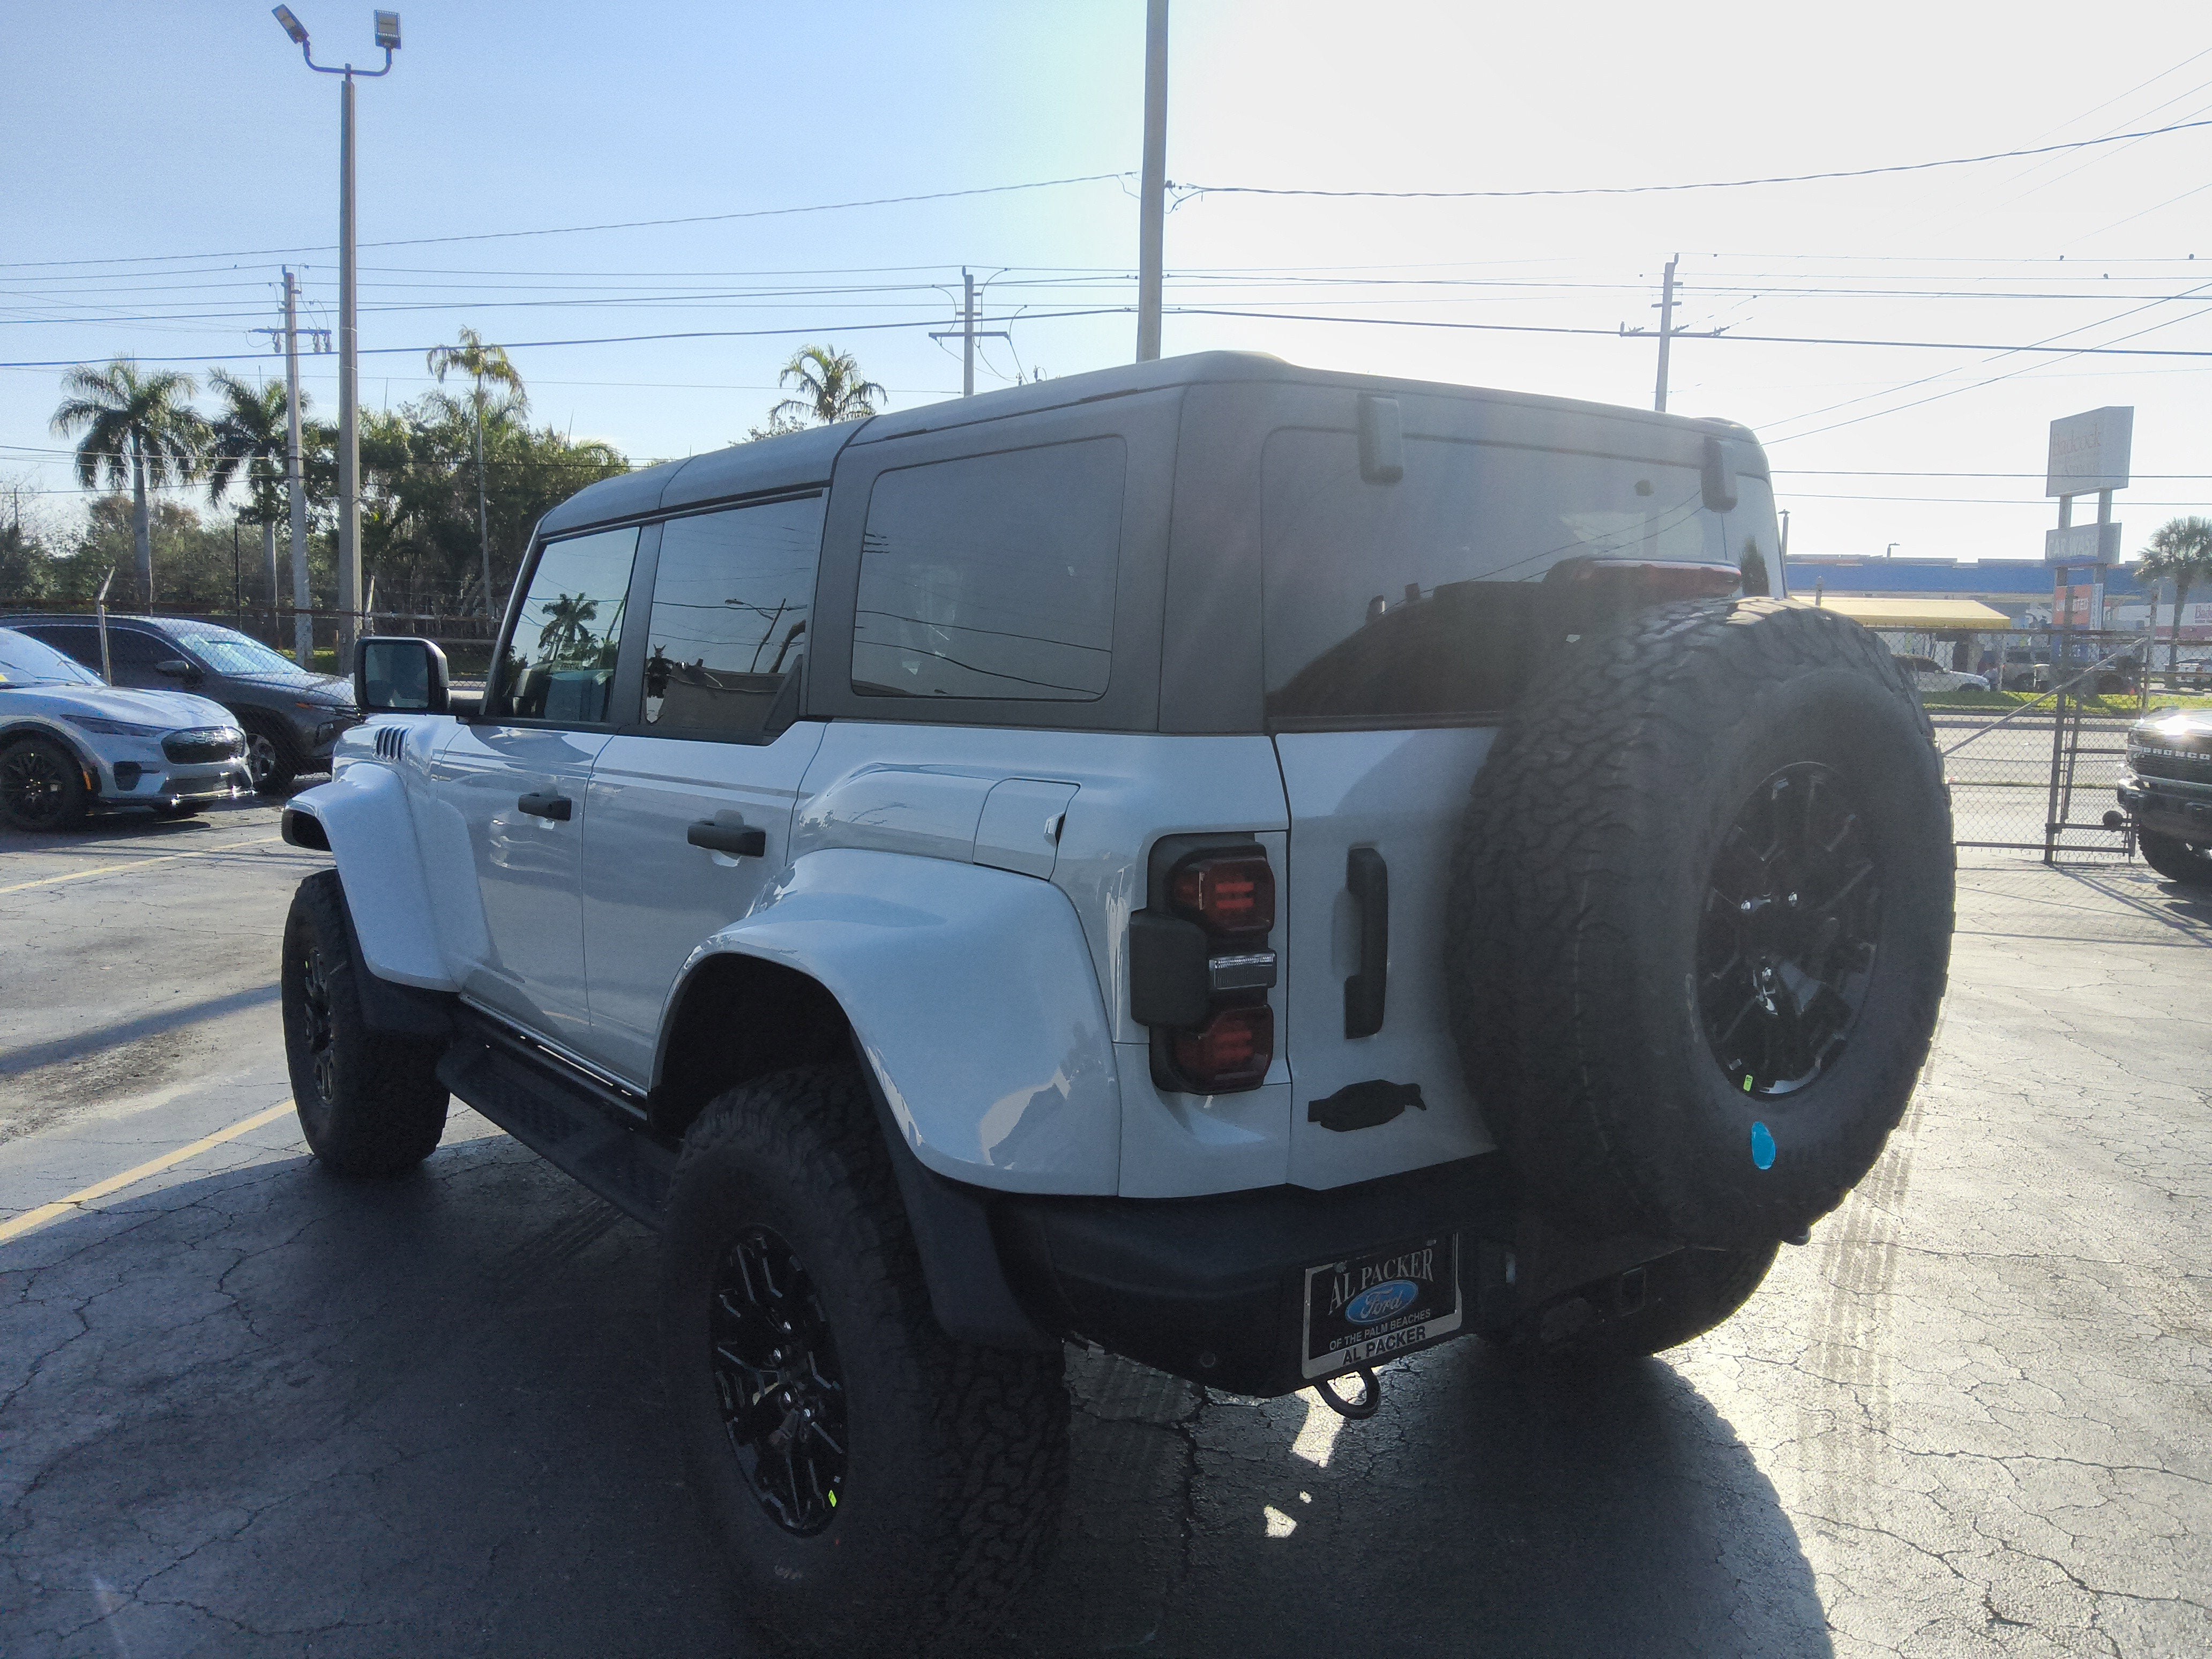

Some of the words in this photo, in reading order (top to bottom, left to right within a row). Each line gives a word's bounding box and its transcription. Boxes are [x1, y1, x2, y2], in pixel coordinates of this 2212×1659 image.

[2046, 538, 2067, 559] CAR
[1328, 1272, 1355, 1316] AL
[1361, 1248, 1434, 1290] PACKER
[1360, 1287, 1404, 1319] Ford
[1329, 1339, 1341, 1351] OF
[1344, 1330, 1362, 1346] THE
[1364, 1323, 1388, 1339] PALM
[1390, 1308, 1431, 1328] BEACHES
[1342, 1347, 1362, 1366] AL
[1366, 1326, 1426, 1358] PACKER
